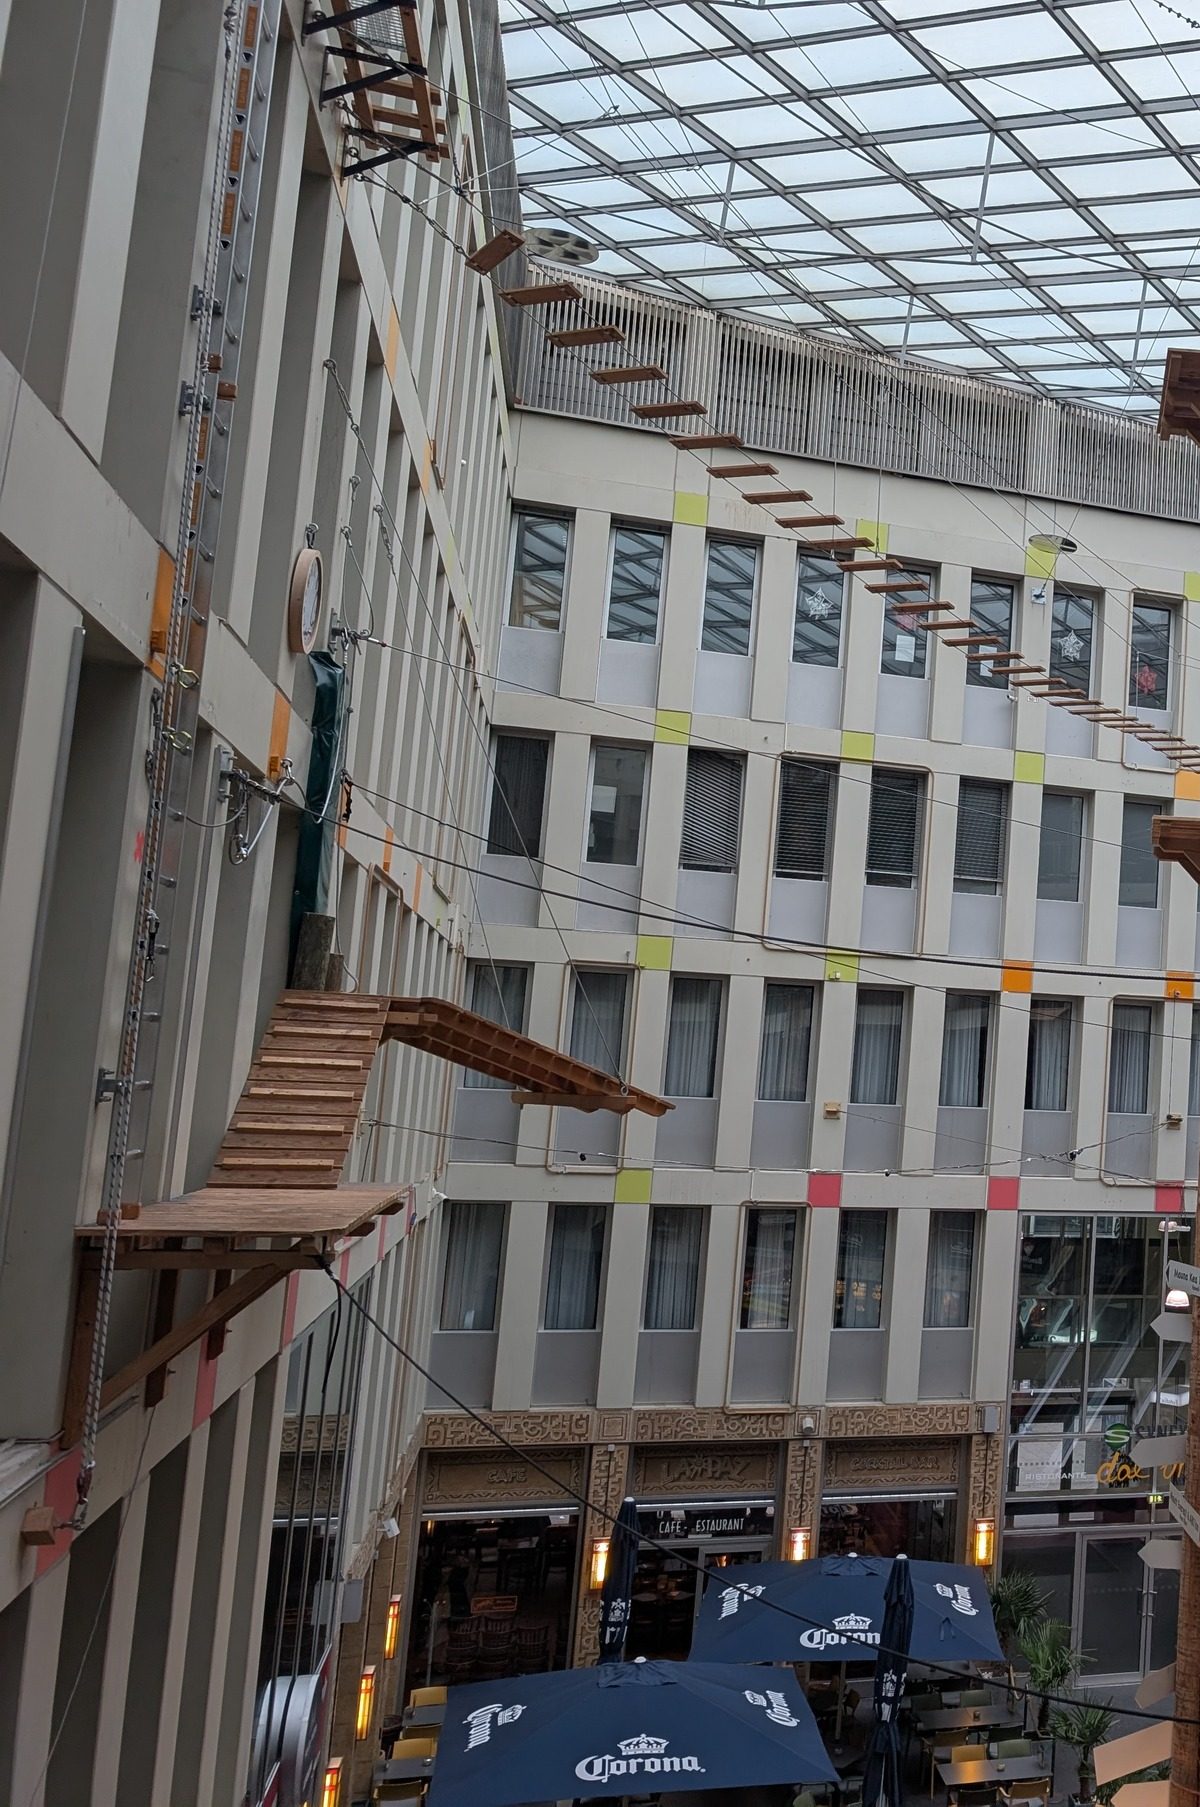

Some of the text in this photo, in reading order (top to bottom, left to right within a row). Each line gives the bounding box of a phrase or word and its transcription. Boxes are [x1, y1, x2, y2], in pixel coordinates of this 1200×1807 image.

[910, 1455, 941, 1470] BAR
[1025, 1472, 1087, 1480] RISTORANTE
[951, 1584, 980, 1616] Corona
[800, 1628, 881, 1650] Coron
[765, 1690, 801, 1727] Corona
[463, 1703, 503, 1752] Corona
